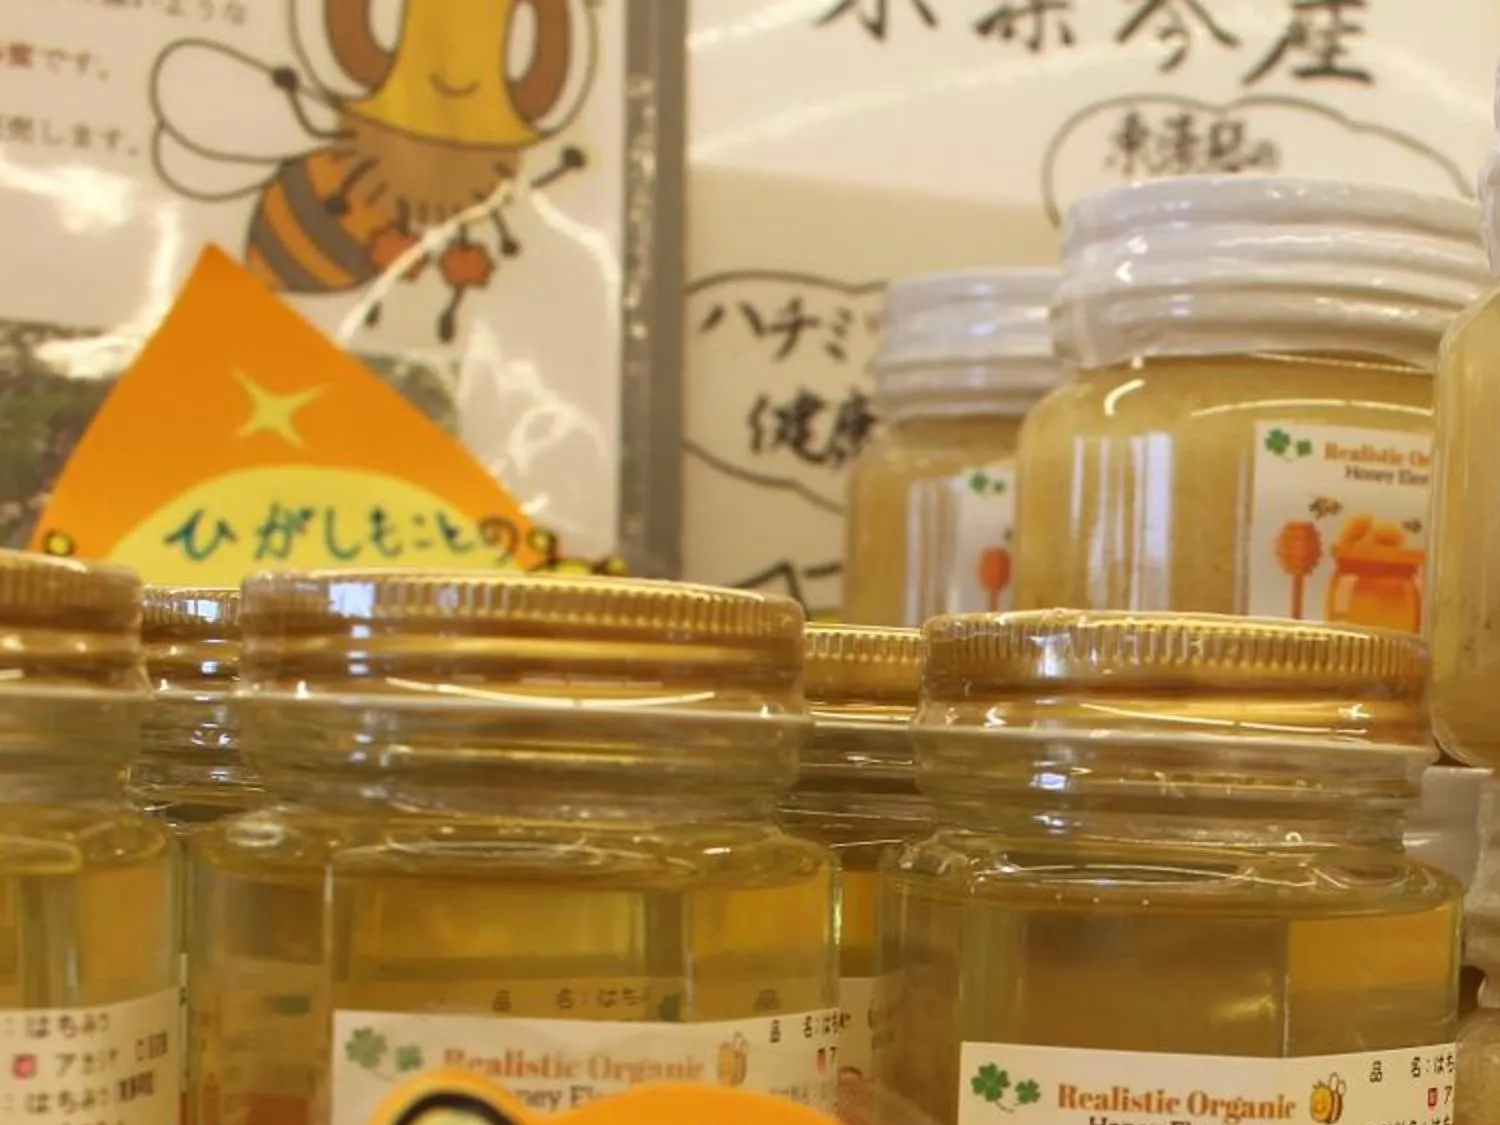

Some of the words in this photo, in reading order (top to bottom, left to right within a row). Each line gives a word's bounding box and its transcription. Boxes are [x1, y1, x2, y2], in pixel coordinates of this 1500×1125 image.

[700, 296, 878, 362] ハチミ
[1057, 1083, 1180, 1115] Realistic
[1187, 1089, 1296, 1124] Organic
